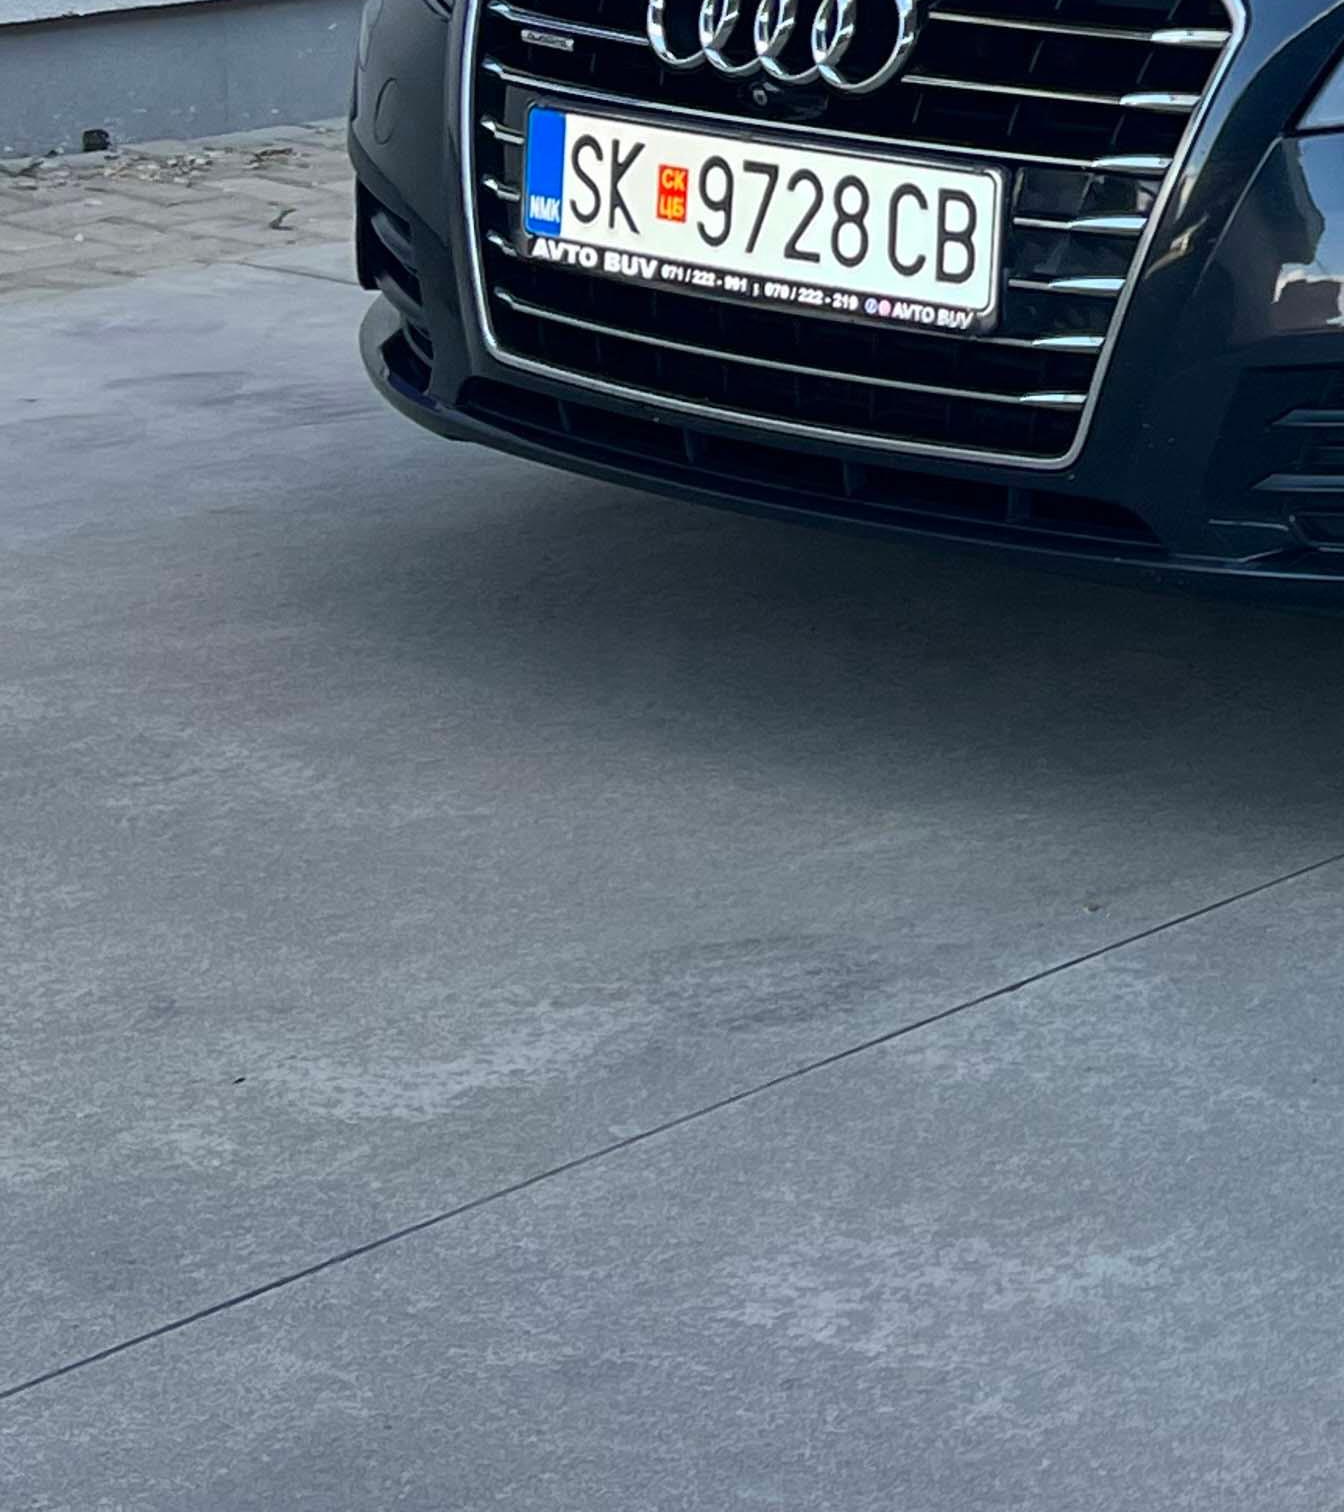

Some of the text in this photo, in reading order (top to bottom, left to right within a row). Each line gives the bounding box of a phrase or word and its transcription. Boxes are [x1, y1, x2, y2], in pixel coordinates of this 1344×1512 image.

[529, 194, 560, 223] NMK
[569, 133, 645, 236] SK
[531, 238, 598, 268] AVTO
[603, 251, 658, 279] BUV
[892, 301, 935, 324] AVTO
[936, 308, 975, 330] BUV
